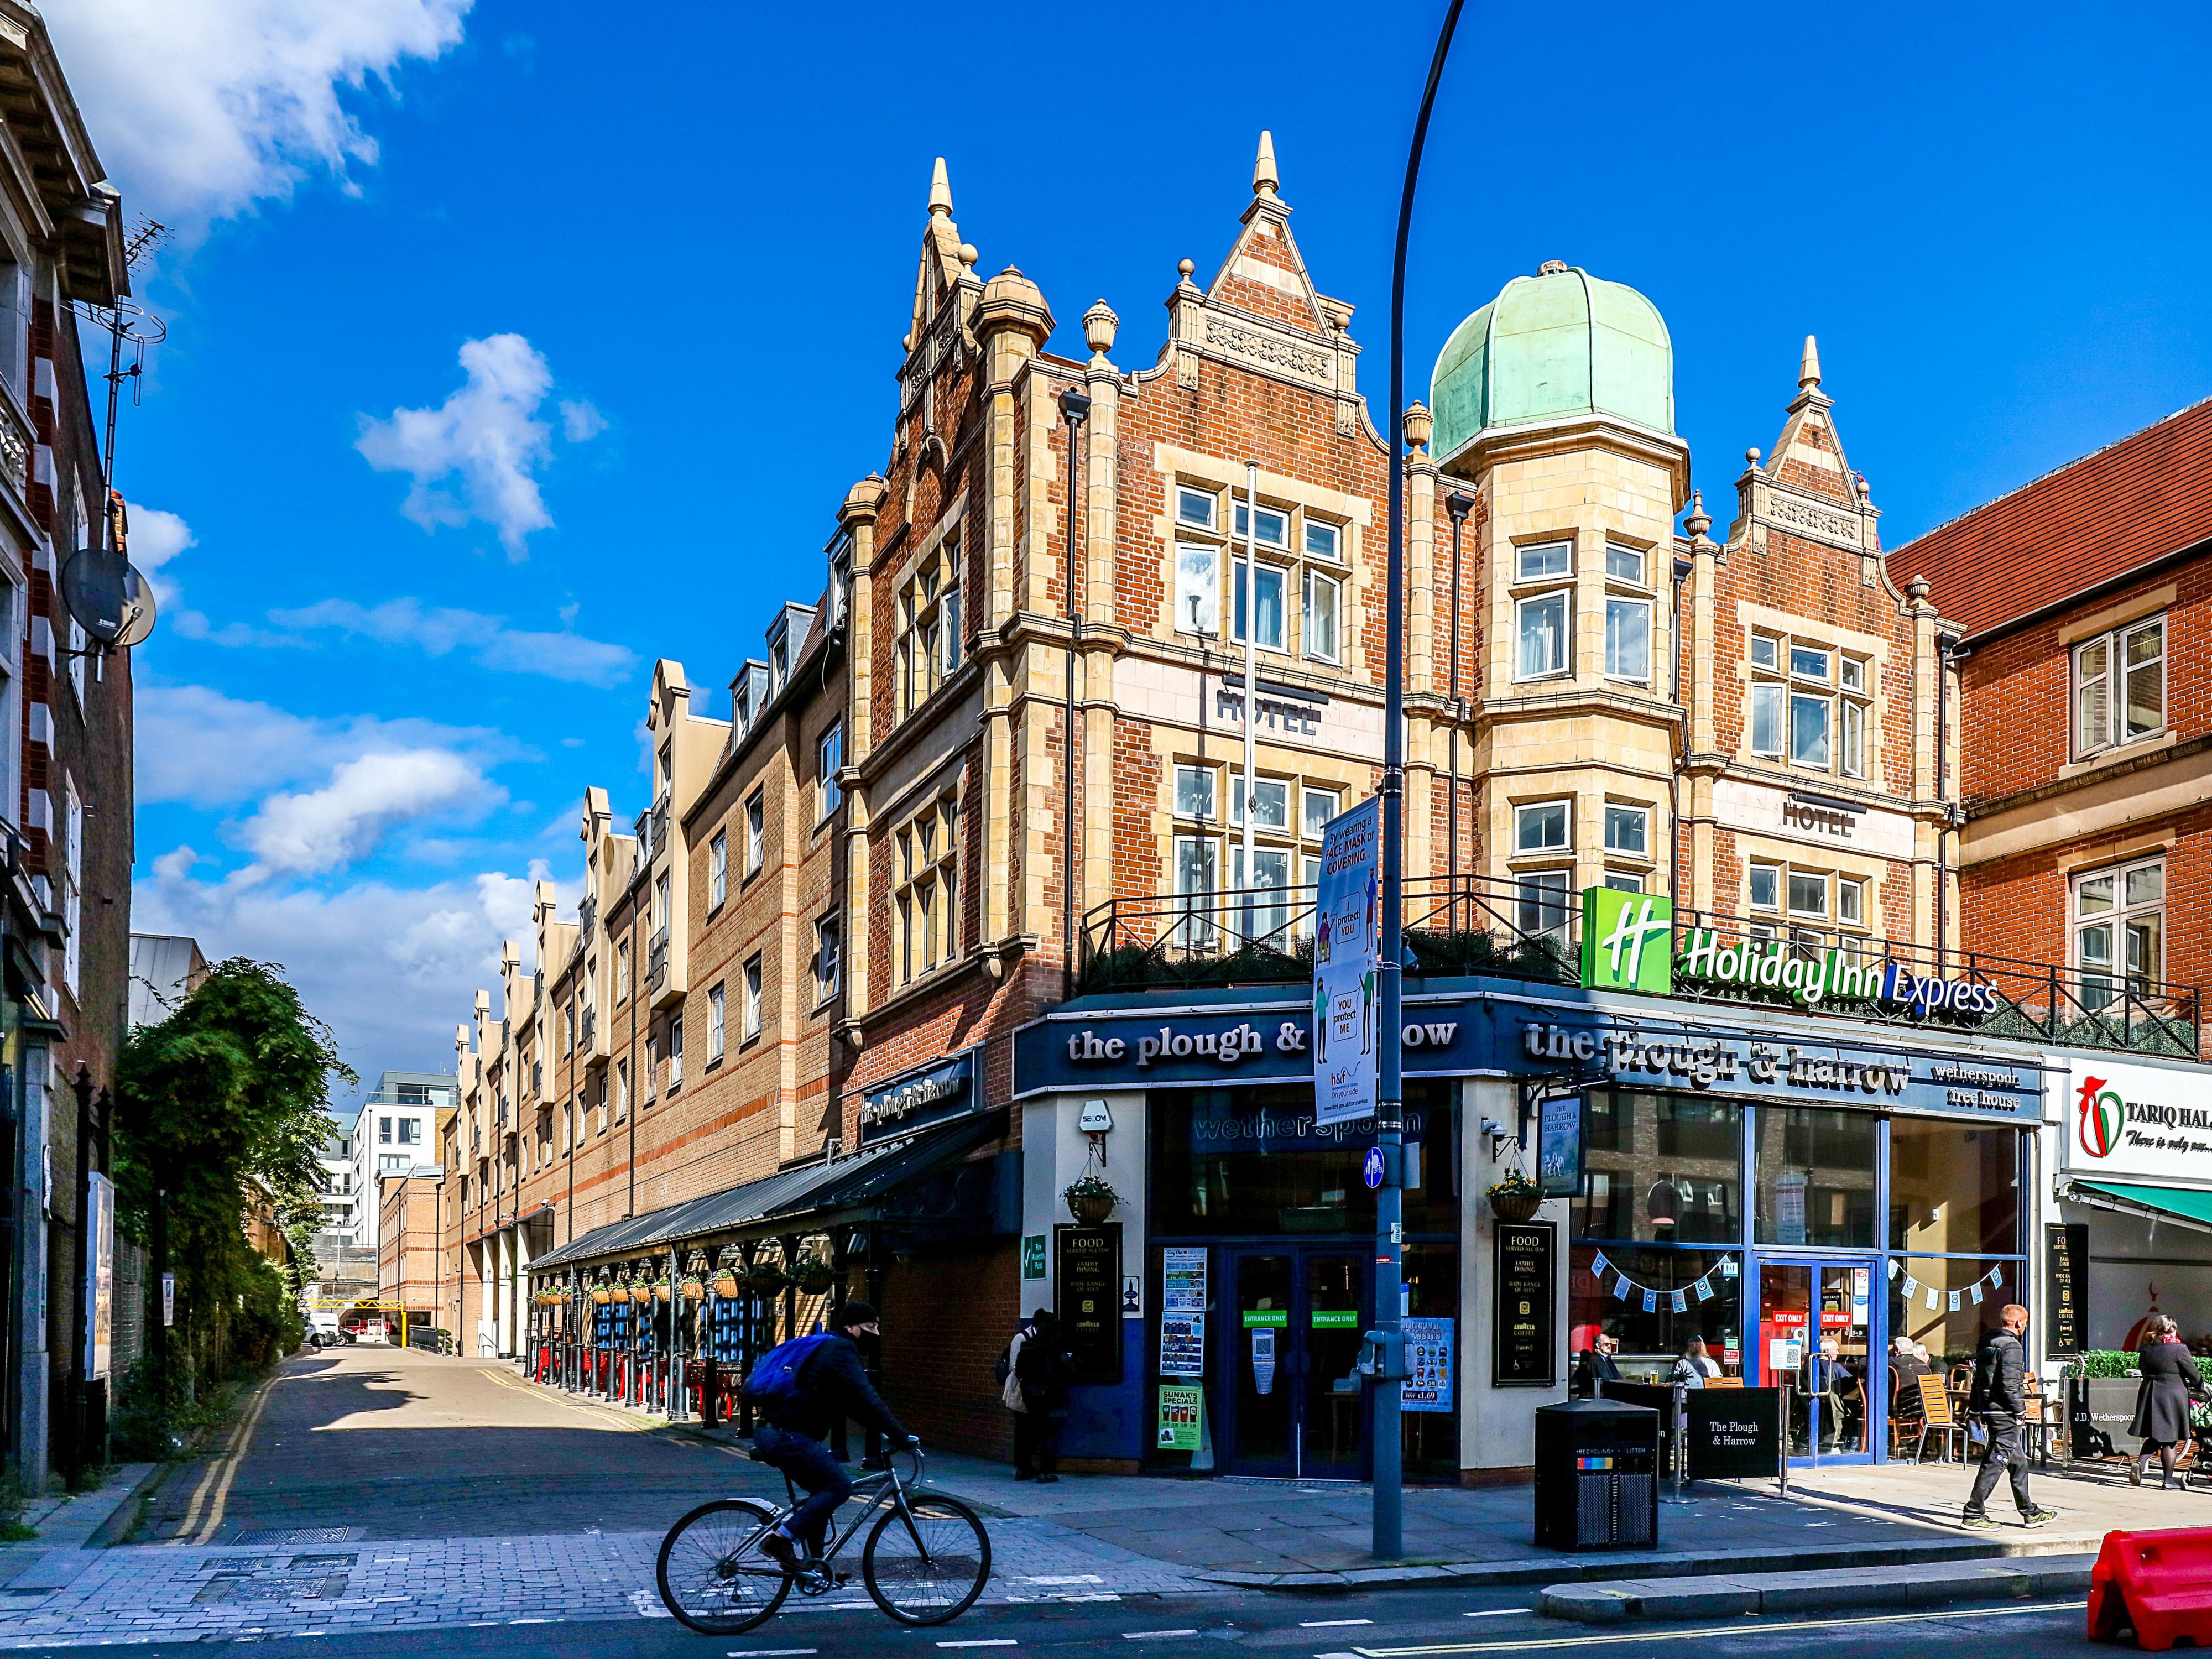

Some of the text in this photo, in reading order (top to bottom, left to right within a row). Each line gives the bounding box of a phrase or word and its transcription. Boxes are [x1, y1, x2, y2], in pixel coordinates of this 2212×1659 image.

[1217, 690, 1316, 735] HOTEL
[1783, 802, 1852, 838] HOTEL
[1329, 816, 1372, 845] By wearing a
[1326, 830, 1375, 861] FACE MASK or
[1327, 849, 1371, 875] COVERING...
[1347, 901, 1349, 911] I
[1337, 910, 1359, 928] protect
[1341, 924, 1354, 937] YOU
[1682, 927, 1999, 1016] Holiday Inn Express
[1338, 999, 1352, 1010] YOU
[1334, 1009, 1356, 1026] protect
[1340, 1024, 1350, 1035] ME
[1068, 1022, 1306, 1066] the plough &
[1524, 1024, 1912, 1091] the plough & harrow
[1931, 1066, 2020, 1087] wetherspoon
[1338, 1091, 1348, 1100] your
[1349, 1087, 1358, 1096] side
[1948, 1087, 2020, 1109] free house
[1544, 1113, 1571, 1123] PLOUGH
[2125, 1102, 2212, 1129] TARIQ HAL
[1194, 1112, 1421, 1142] wetherspon
[1545, 1121, 1577, 1133] HARROW
[2156, 1137, 2166, 1149] is
[2167, 1136, 2189, 1154] only
[1073, 1238, 1103, 1248] FOOD
[1511, 1236, 1539, 1246] FOOD
[2075, 1413, 2089, 1422] J.D.
[1709, 1422, 1759, 1433] The Plough
[1713, 1435, 1756, 1446] & Harrow
